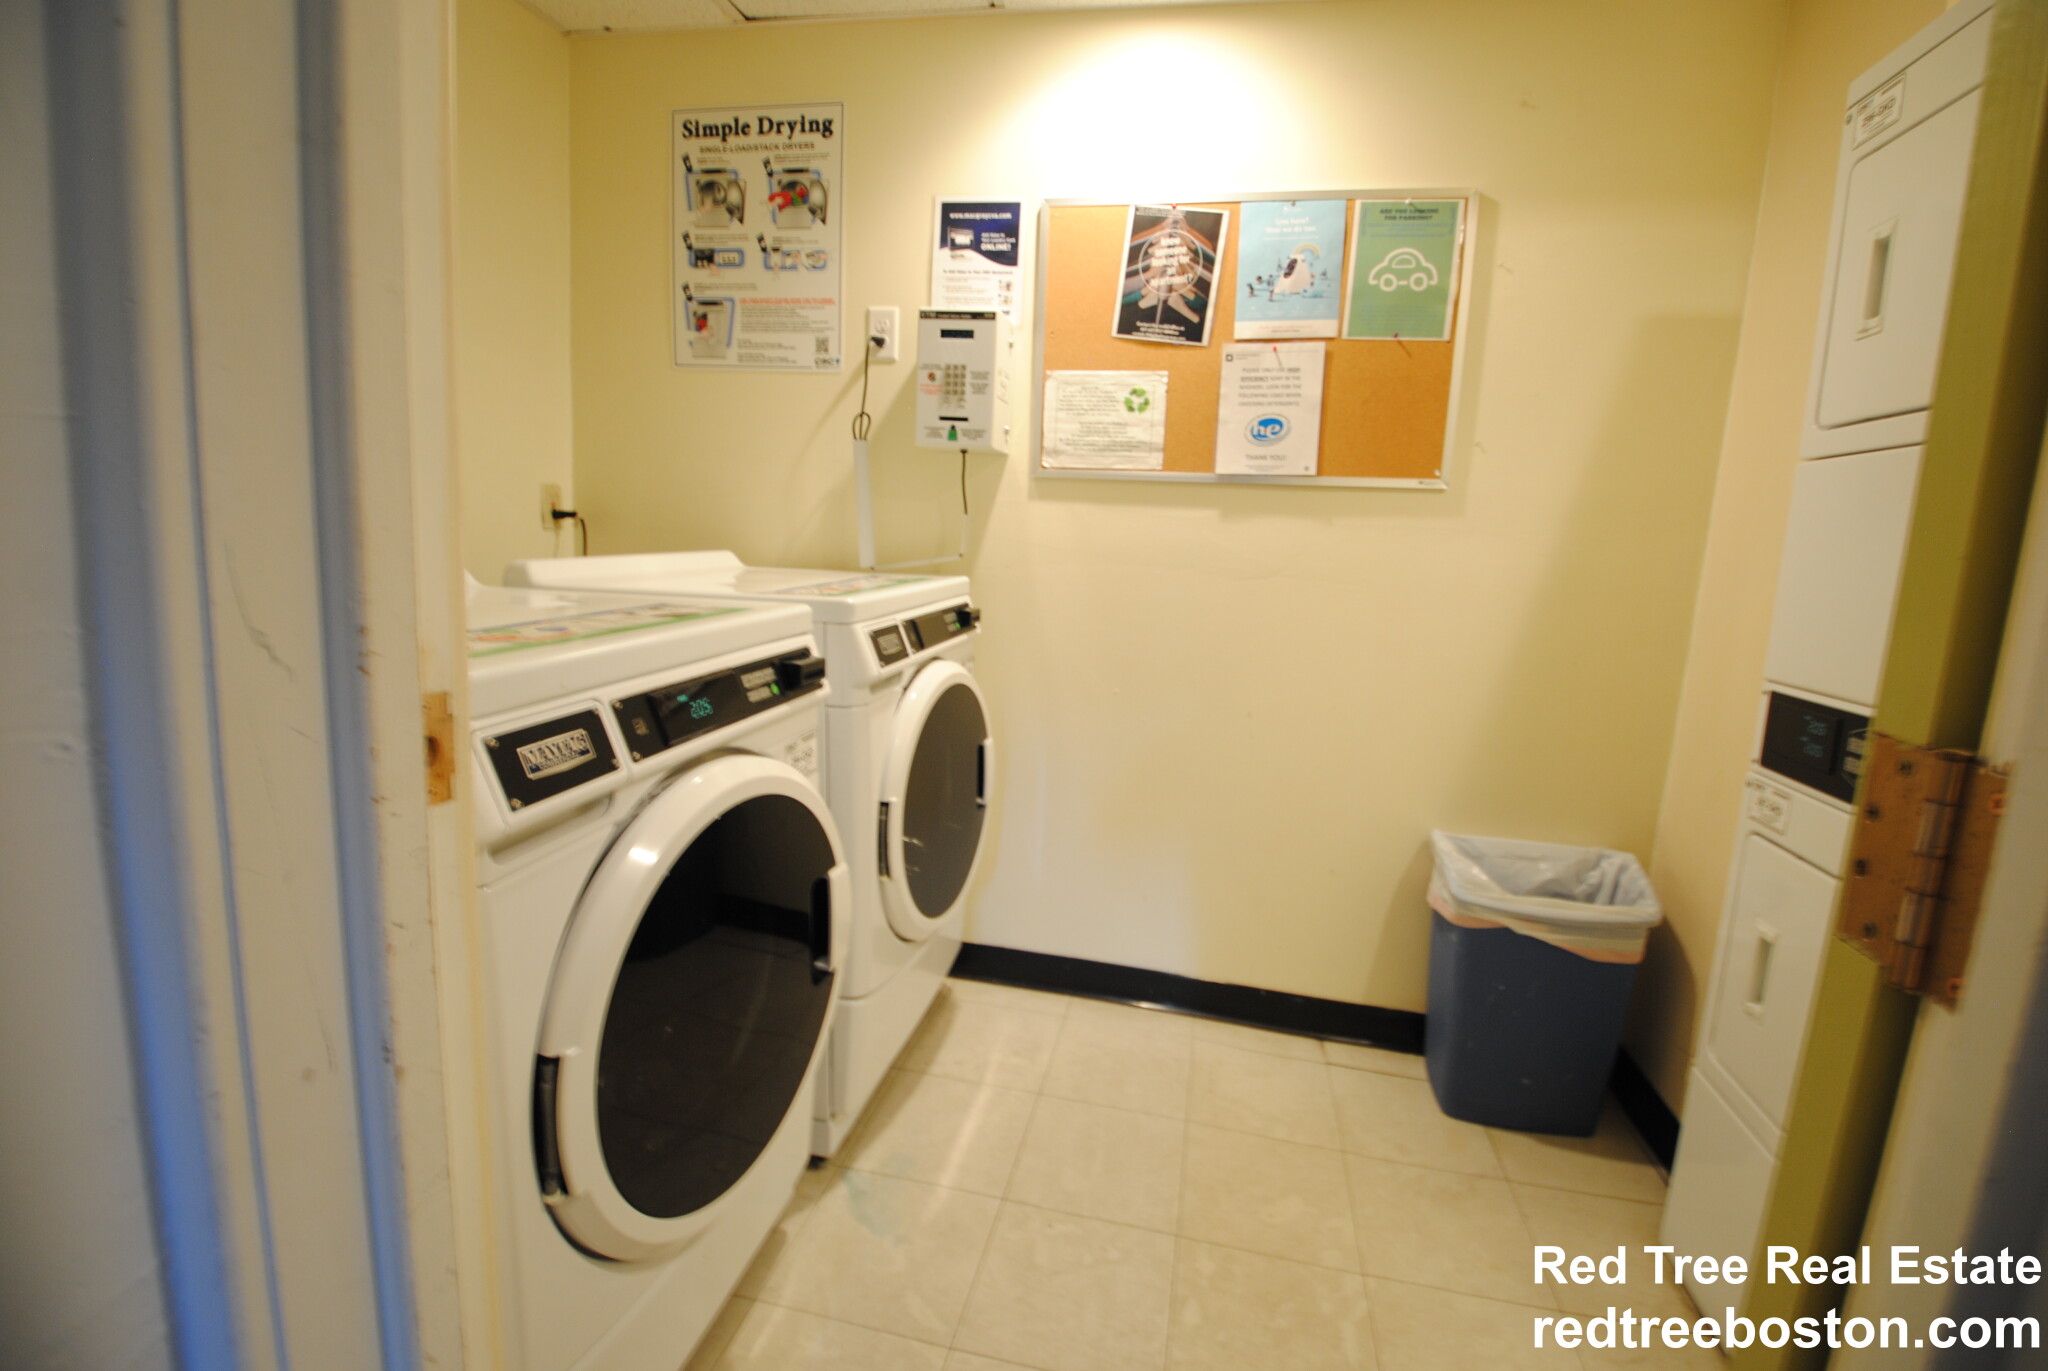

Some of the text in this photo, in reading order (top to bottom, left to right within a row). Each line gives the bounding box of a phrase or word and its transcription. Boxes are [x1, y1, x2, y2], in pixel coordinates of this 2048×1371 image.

[682, 114, 834, 142] Simple Drying
[782, 141, 815, 150] DRYERS
[980, 243, 1012, 251] ONLINE!
